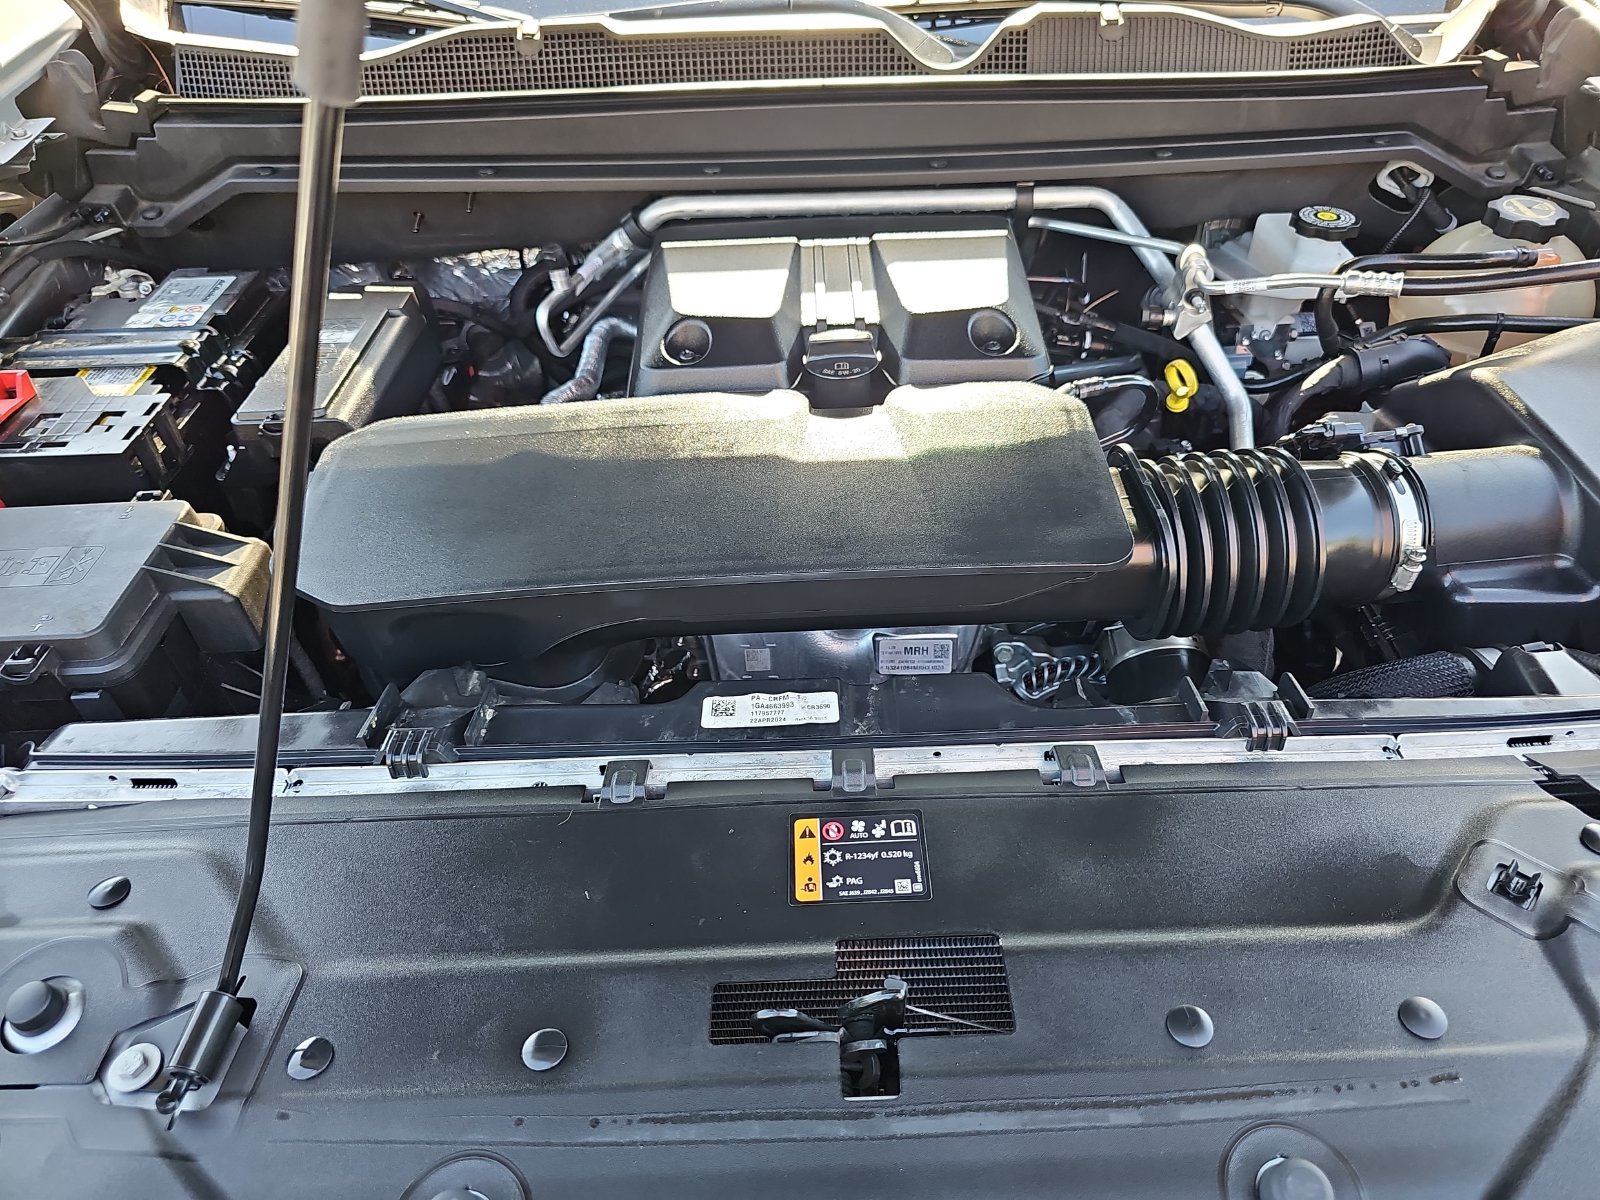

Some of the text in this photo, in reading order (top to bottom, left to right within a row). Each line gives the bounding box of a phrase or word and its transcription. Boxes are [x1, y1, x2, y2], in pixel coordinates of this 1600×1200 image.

[904, 646, 929, 655] MRH
[845, 851, 879, 860] R-1234yf
[904, 850, 913, 858] kg
[846, 877, 863, 885] PAG
